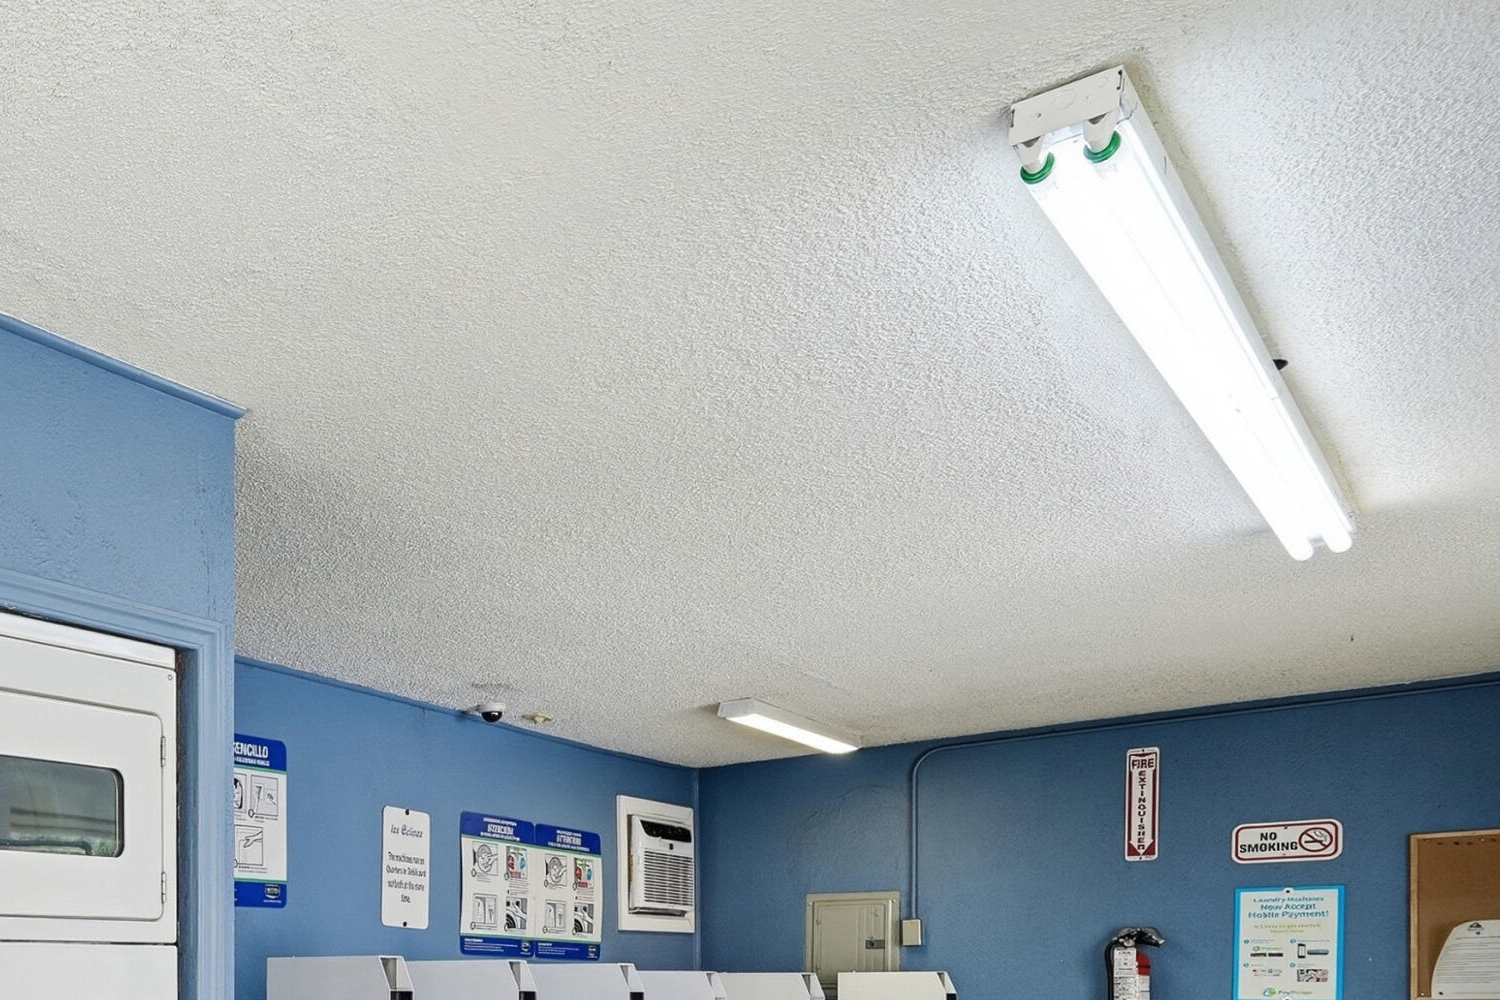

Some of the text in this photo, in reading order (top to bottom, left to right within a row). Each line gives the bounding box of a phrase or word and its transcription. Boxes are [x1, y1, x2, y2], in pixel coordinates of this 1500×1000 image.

[1132, 758, 1154, 769] FIRE
[1260, 832, 1277, 841] NO
[1240, 842, 1298, 853] SMOKING
[1281, 910, 1329, 919] Payment!
